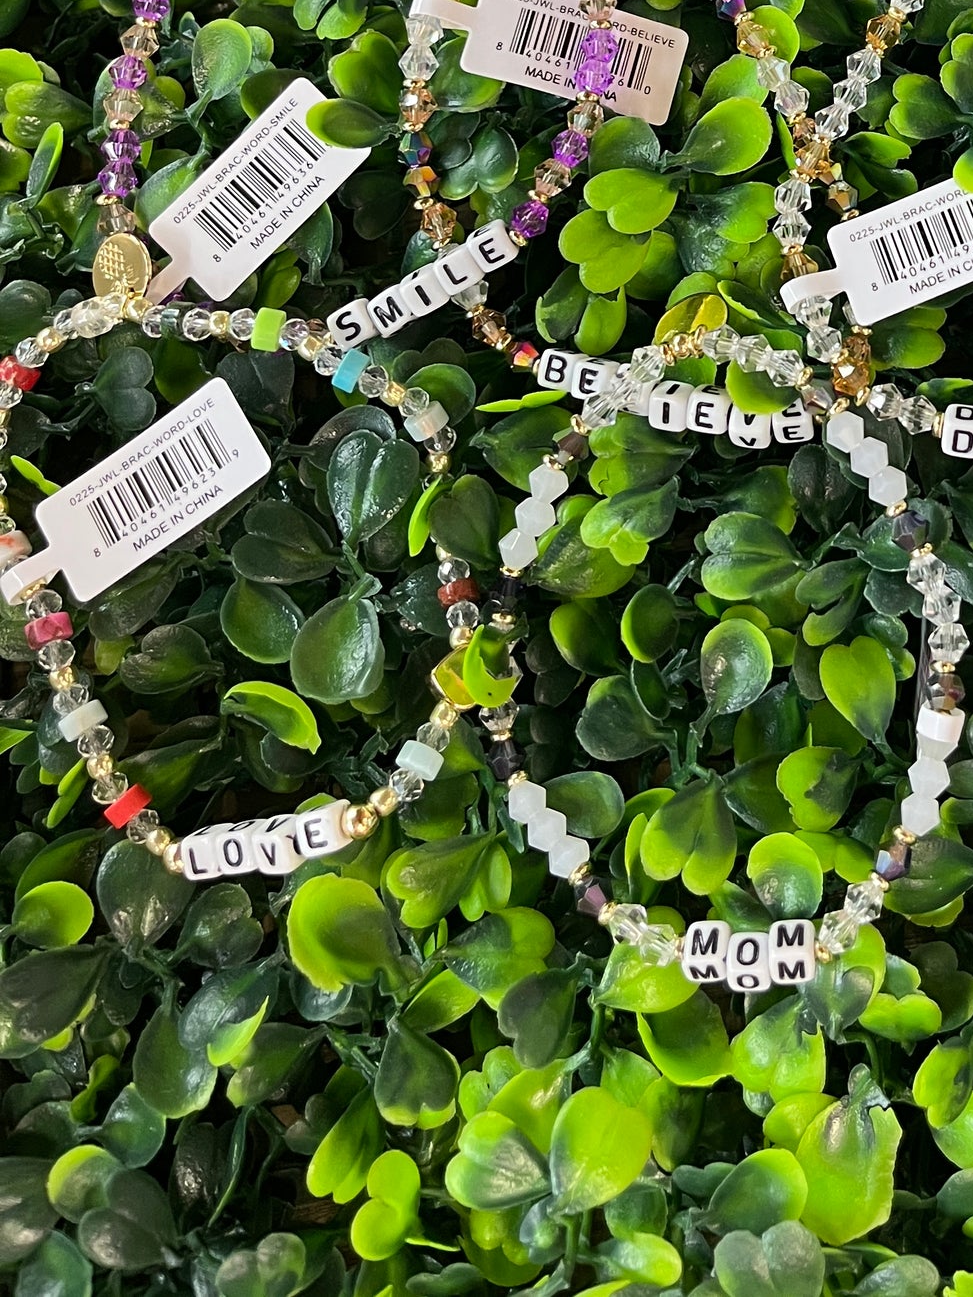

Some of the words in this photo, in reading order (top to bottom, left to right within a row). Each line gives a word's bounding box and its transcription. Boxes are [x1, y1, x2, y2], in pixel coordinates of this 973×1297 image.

[496, 42, 502, 50] 8
[526, 49, 570, 69] 40461
[644, 86, 650, 94] 0
[525, 66, 561, 86] MADE
[564, 78, 576, 90] IN
[174, 98, 298, 224] 0225-JWL-BRAC-WORD-SMILE
[213, 254, 221, 262] 8
[236, 203, 273, 239] 40461
[277, 162, 313, 199] 49636
[250, 219, 282, 249] MADE
[282, 206, 293, 221] IN
[294, 176, 325, 208] CHINA
[336, 228, 505, 341] SMILE
[872, 282, 878, 291] 8
[901, 256, 945, 280] 40461
[909, 275, 945, 294] MADE
[948, 268, 960, 278] IN
[544, 355, 805, 446] BEIEVE
[70, 398, 215, 506] 0225-JWL-BRAC-WORD-LOVE
[94, 548, 101, 557] 8
[122, 504, 165, 537] 40461
[174, 469, 216, 504] 49623
[233, 449, 239, 457] 9
[133, 521, 169, 551] MADE
[172, 513, 184, 526] IN
[187, 484, 223, 515] CHINA
[189, 818, 328, 874] LOVE
[690, 924, 805, 988] MOM
